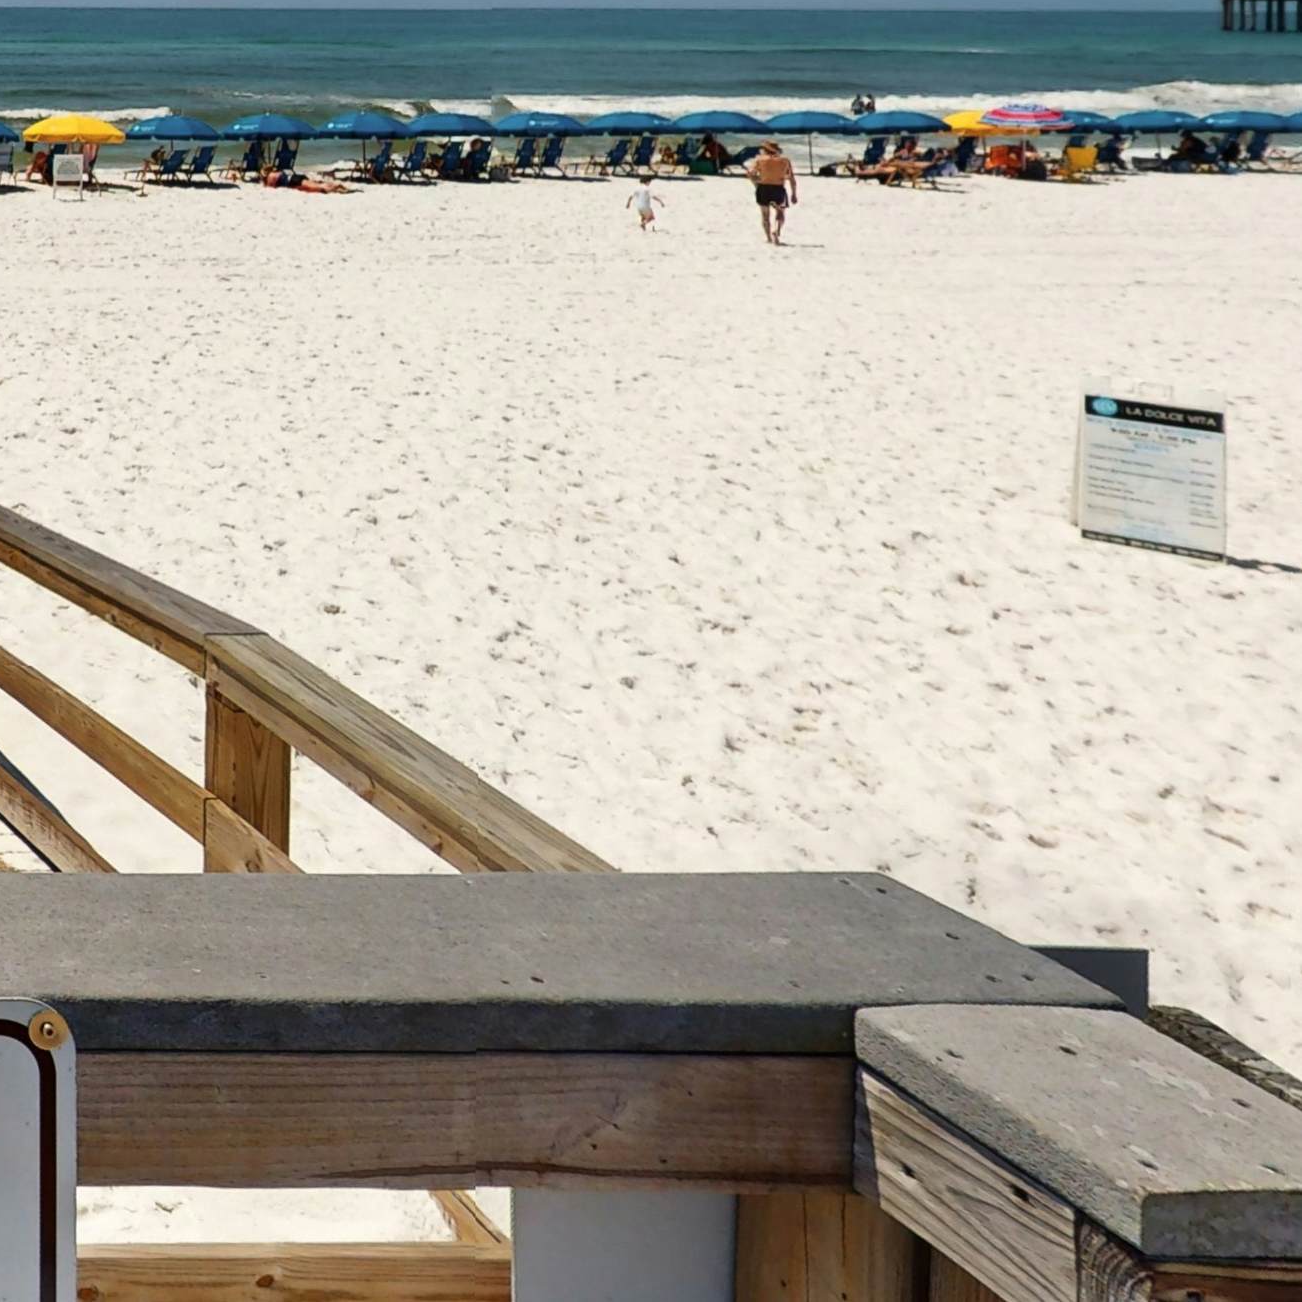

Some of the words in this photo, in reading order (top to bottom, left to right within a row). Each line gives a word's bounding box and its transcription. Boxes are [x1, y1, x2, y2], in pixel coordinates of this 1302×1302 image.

[1125, 407, 1142, 417] LA
[1145, 410, 1185, 423] DOLCE
[1187, 415, 1217, 426] VITA
